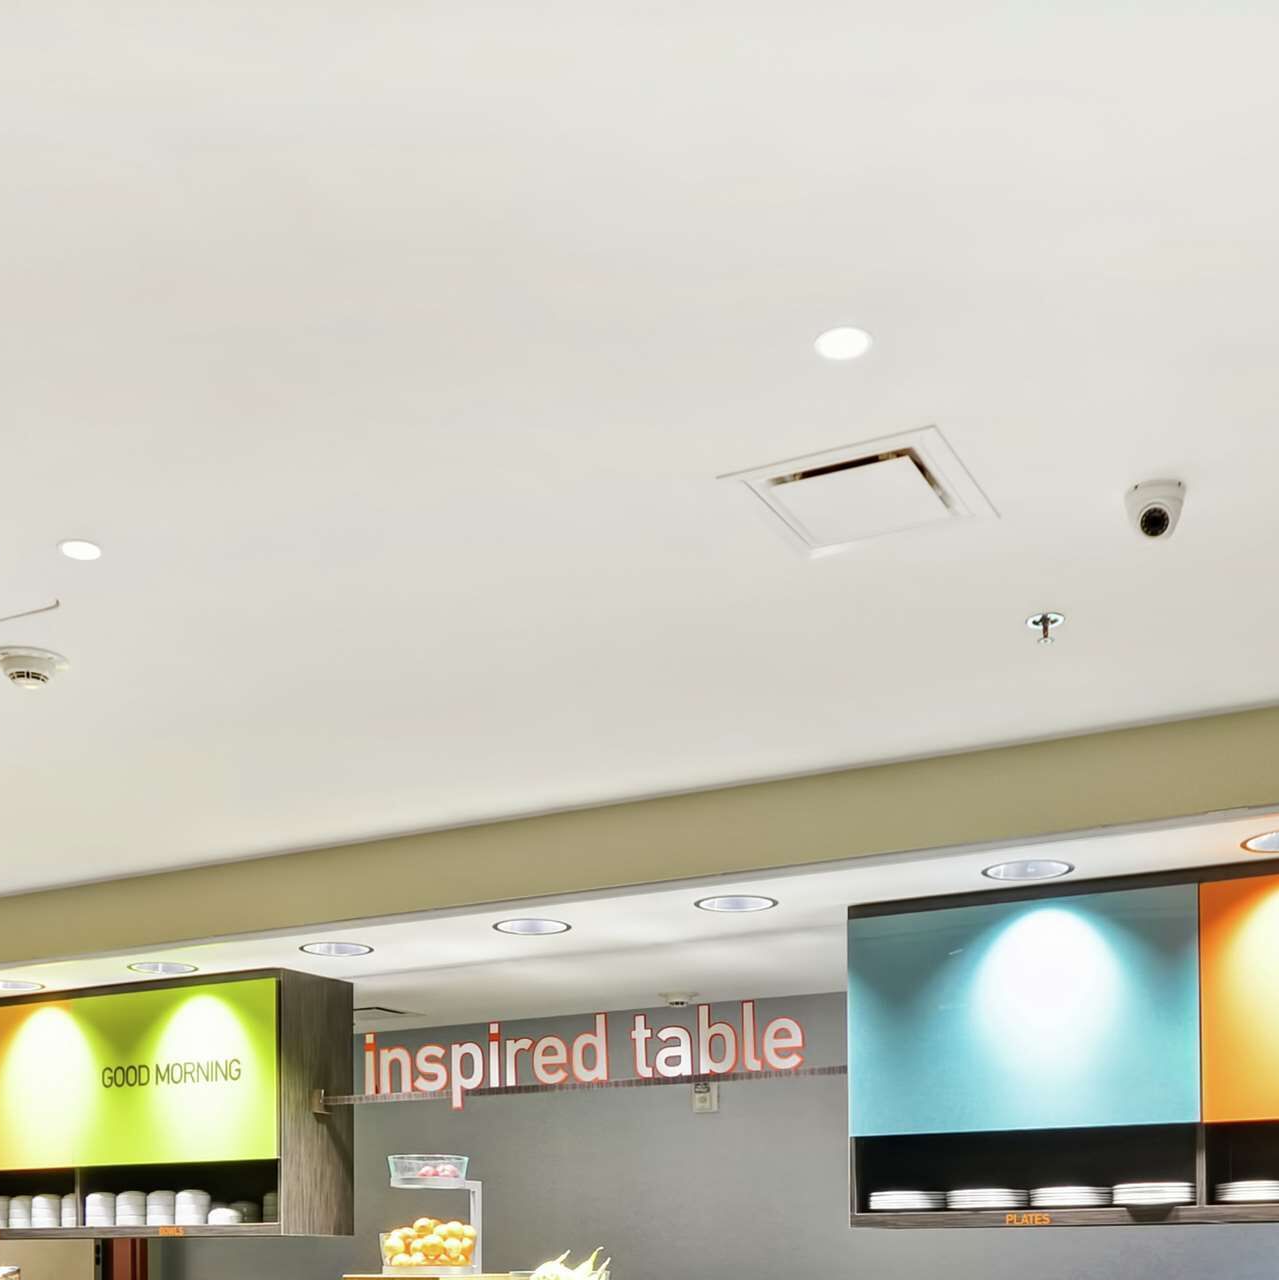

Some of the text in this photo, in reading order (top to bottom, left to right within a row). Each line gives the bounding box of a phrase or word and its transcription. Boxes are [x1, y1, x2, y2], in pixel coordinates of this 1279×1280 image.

[364, 1000, 805, 1110] inspired table
[102, 1058, 241, 1088] GOOD MORNING
[1006, 1212, 1051, 1225] PLATES
